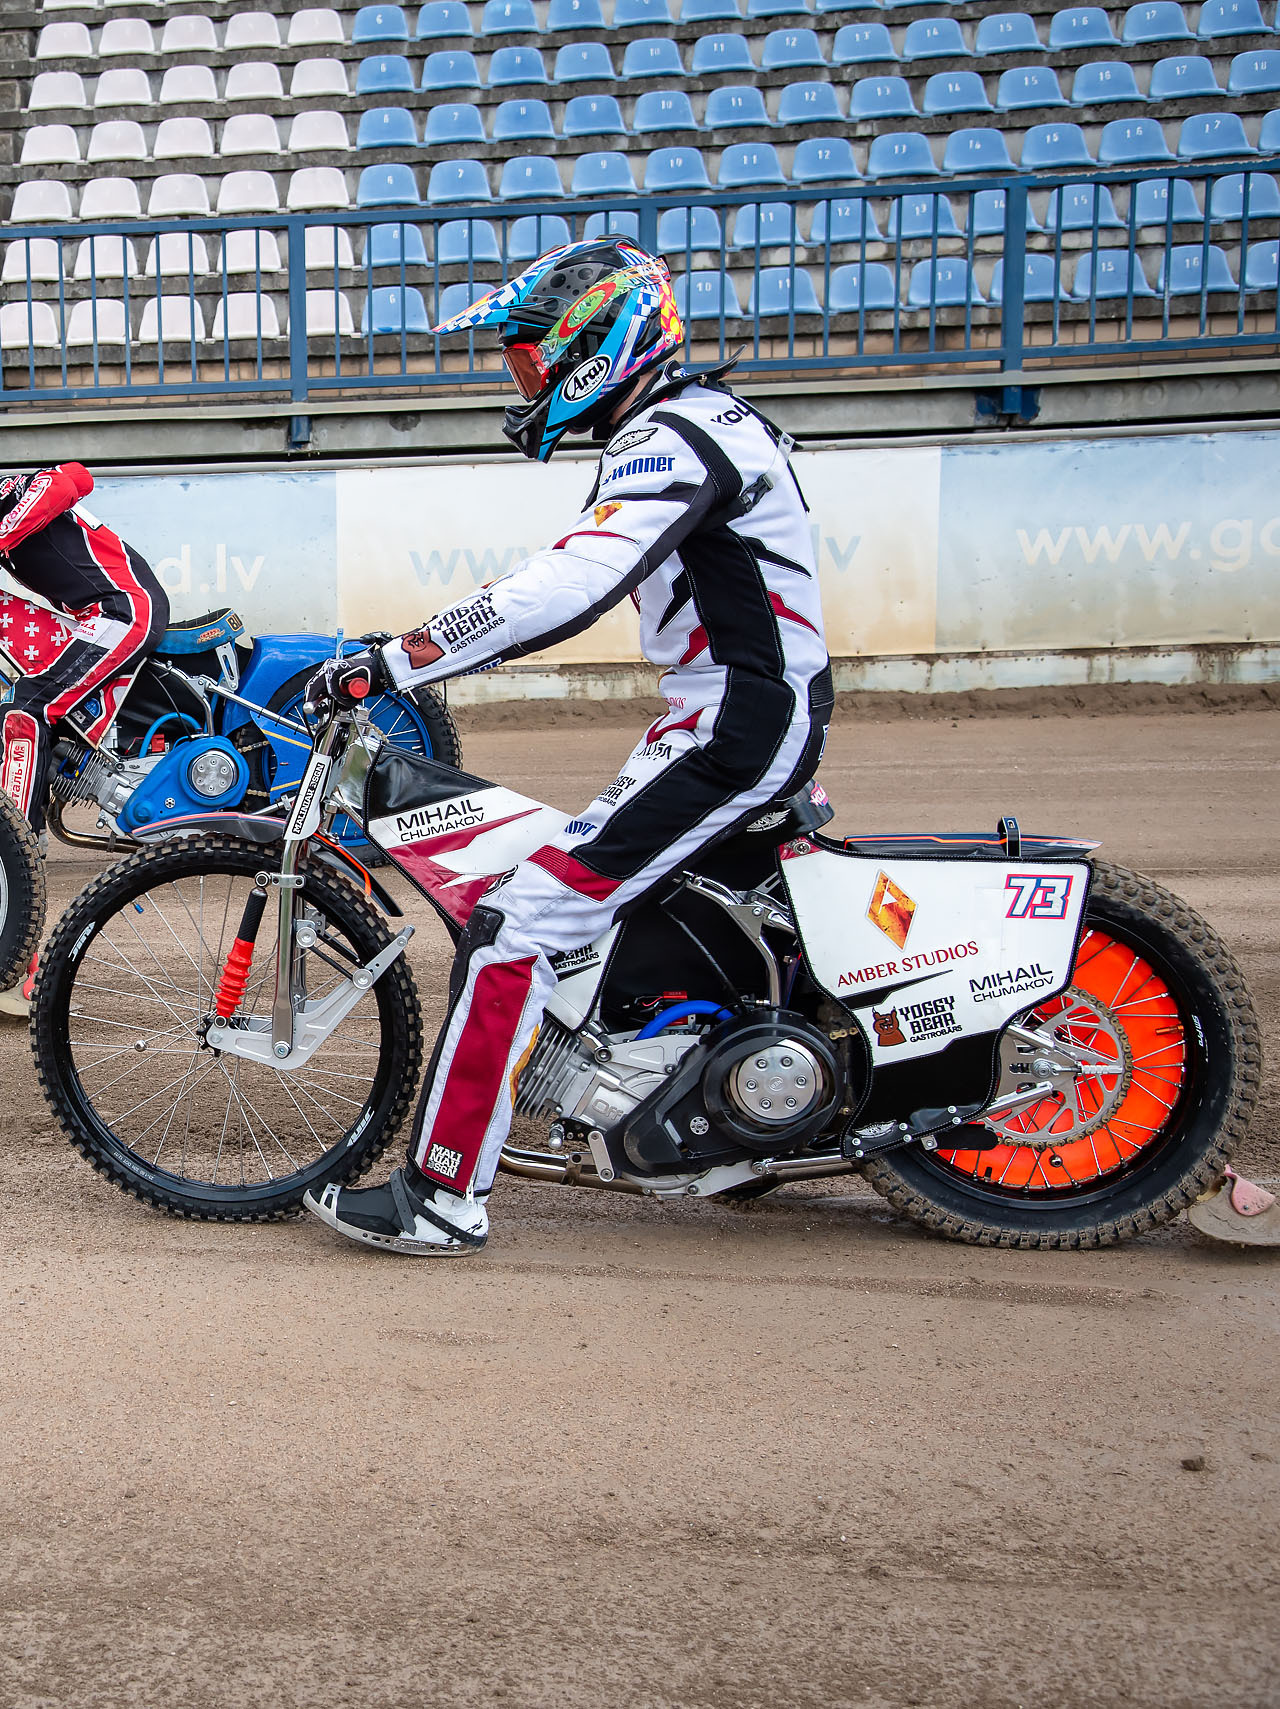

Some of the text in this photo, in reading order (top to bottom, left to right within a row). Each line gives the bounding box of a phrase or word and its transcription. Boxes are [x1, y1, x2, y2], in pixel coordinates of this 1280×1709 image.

[1027, 264, 1034, 275] 4
[1271, 252, 1278, 264] 1
[852, 276, 857, 287] 1
[569, 357, 606, 401] Arai
[450, 616, 506, 655] GASTROBARS
[396, 799, 484, 832] MIHAIL
[401, 812, 485, 842] CHUMAKOV
[1005, 873, 1073, 920] 73
[555, 951, 600, 970] ASTROBARS
[837, 940, 980, 988] AMBER STUDIOS
[969, 963, 1054, 993] MIHAIL
[972, 975, 1055, 1003] CHUMAKOV
[909, 1024, 963, 1043] GASTROBARS
[910, 1012, 957, 1035] BEAR
[592, 1097, 624, 1121] Off
